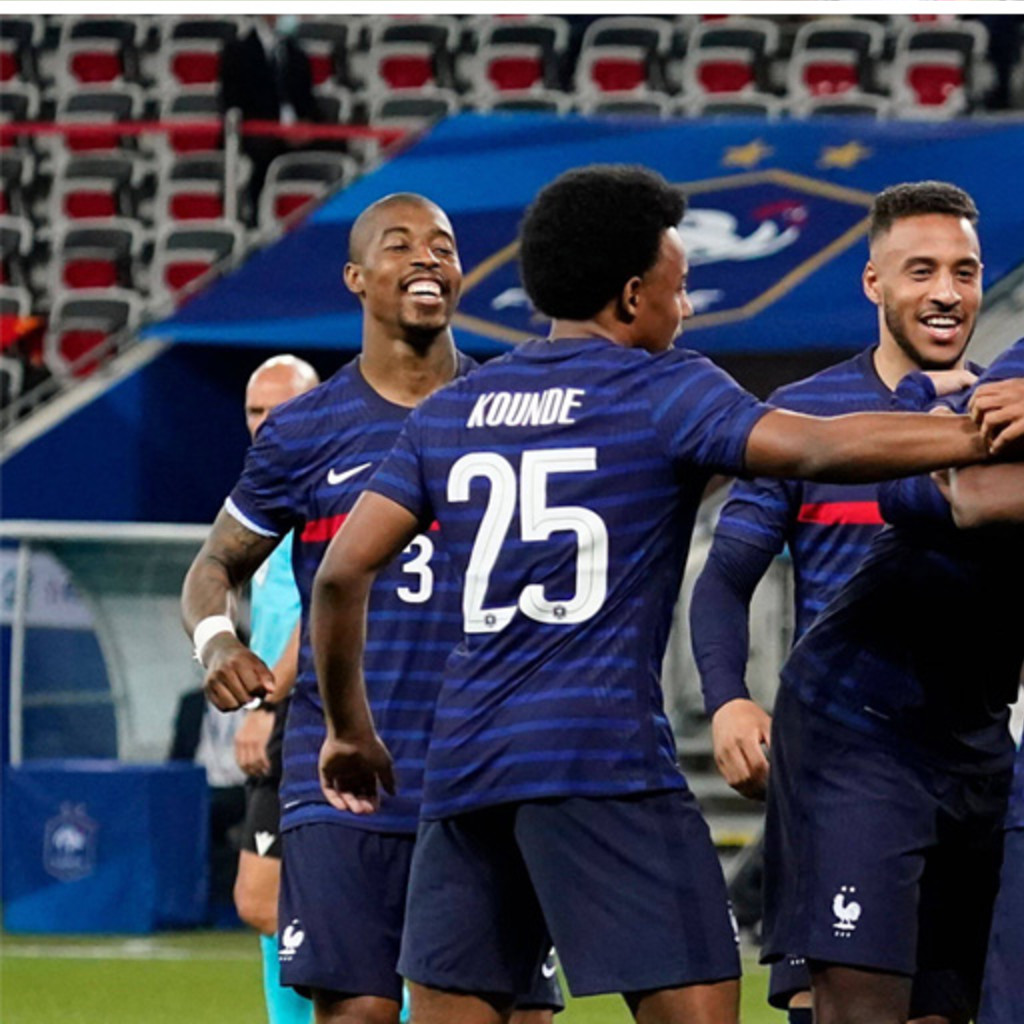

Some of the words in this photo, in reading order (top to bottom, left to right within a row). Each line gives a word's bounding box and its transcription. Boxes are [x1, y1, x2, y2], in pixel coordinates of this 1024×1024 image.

[467, 387, 586, 428] KOUNDE
[397, 534, 434, 603] 3
[447, 447, 608, 633] 25
